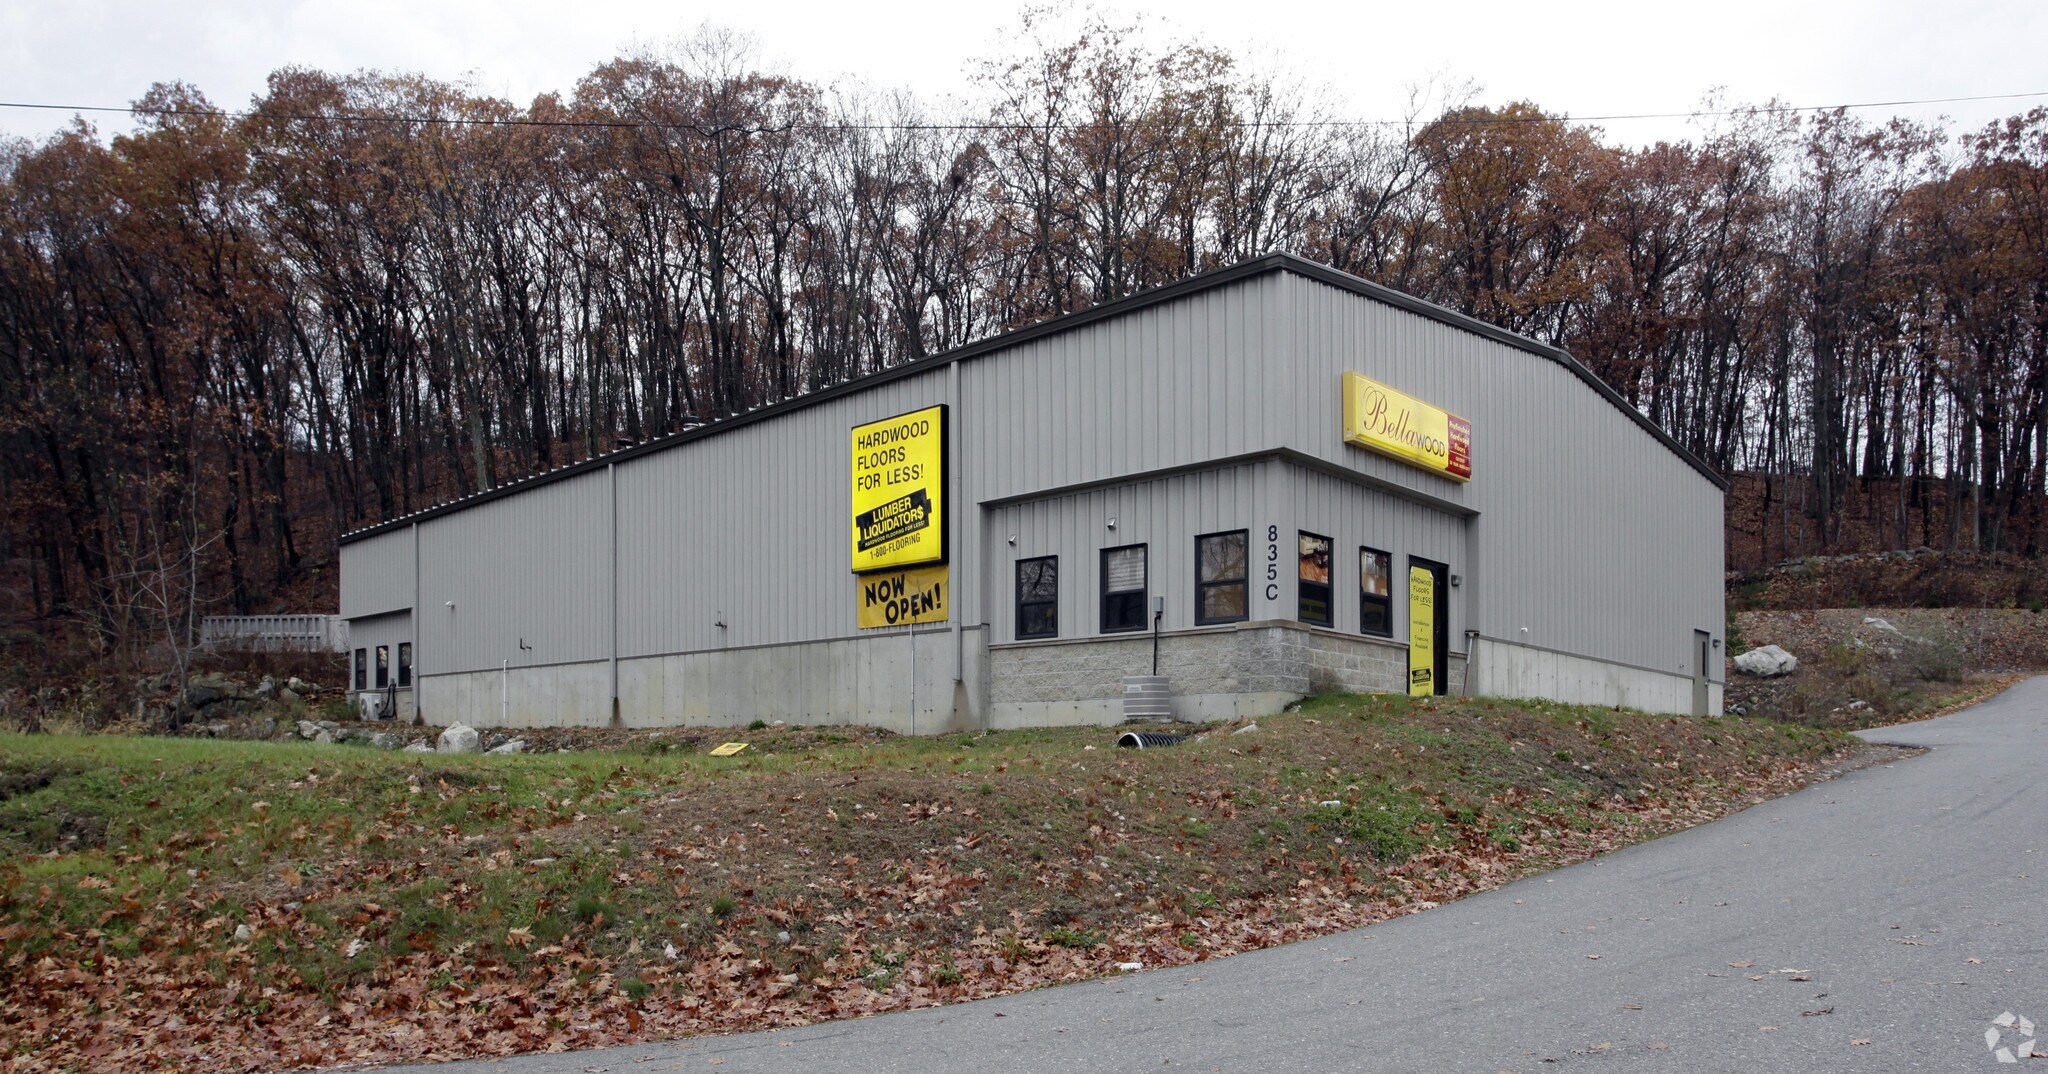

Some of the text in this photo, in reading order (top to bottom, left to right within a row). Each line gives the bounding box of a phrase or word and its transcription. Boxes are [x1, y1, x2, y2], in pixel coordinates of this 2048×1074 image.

[857, 419, 930, 451] HARDWOOD
[857, 445, 906, 472] FLOORS
[857, 463, 924, 492] FOR LESS!
[872, 496, 912, 523] LUMBER
[864, 520, 925, 547] HARDWOOD FLOORING FOR LESS!
[869, 532, 921, 560] 1-800-FLOORING
[865, 573, 906, 608] NOW
[885, 582, 942, 625] OPEN!
[1411, 594, 1419, 602] FOR
[1413, 585, 1430, 595] FLOORS
